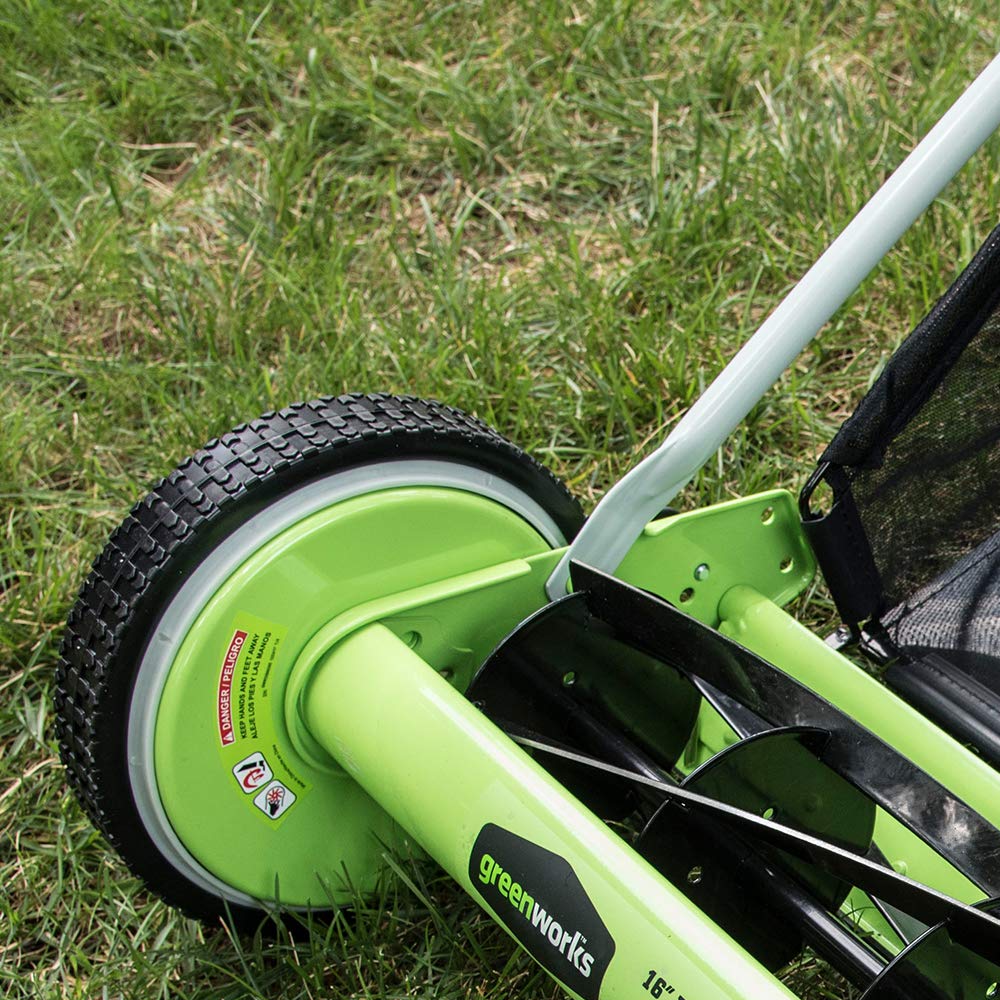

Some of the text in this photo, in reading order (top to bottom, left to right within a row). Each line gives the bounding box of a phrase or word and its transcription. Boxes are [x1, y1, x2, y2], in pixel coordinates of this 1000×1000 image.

[248, 633, 259, 655] AWAY
[256, 632, 271, 659] MANOS
[223, 637, 244, 682] PELIGRO
[242, 656, 251, 675] FEET
[251, 661, 260, 675] LAS
[248, 684, 256, 700] PIES
[221, 689, 231, 731] DANGER
[239, 721, 247, 739] KEEP
[249, 717, 258, 739] ALEJE
[478, 853, 595, 978] greenworks
